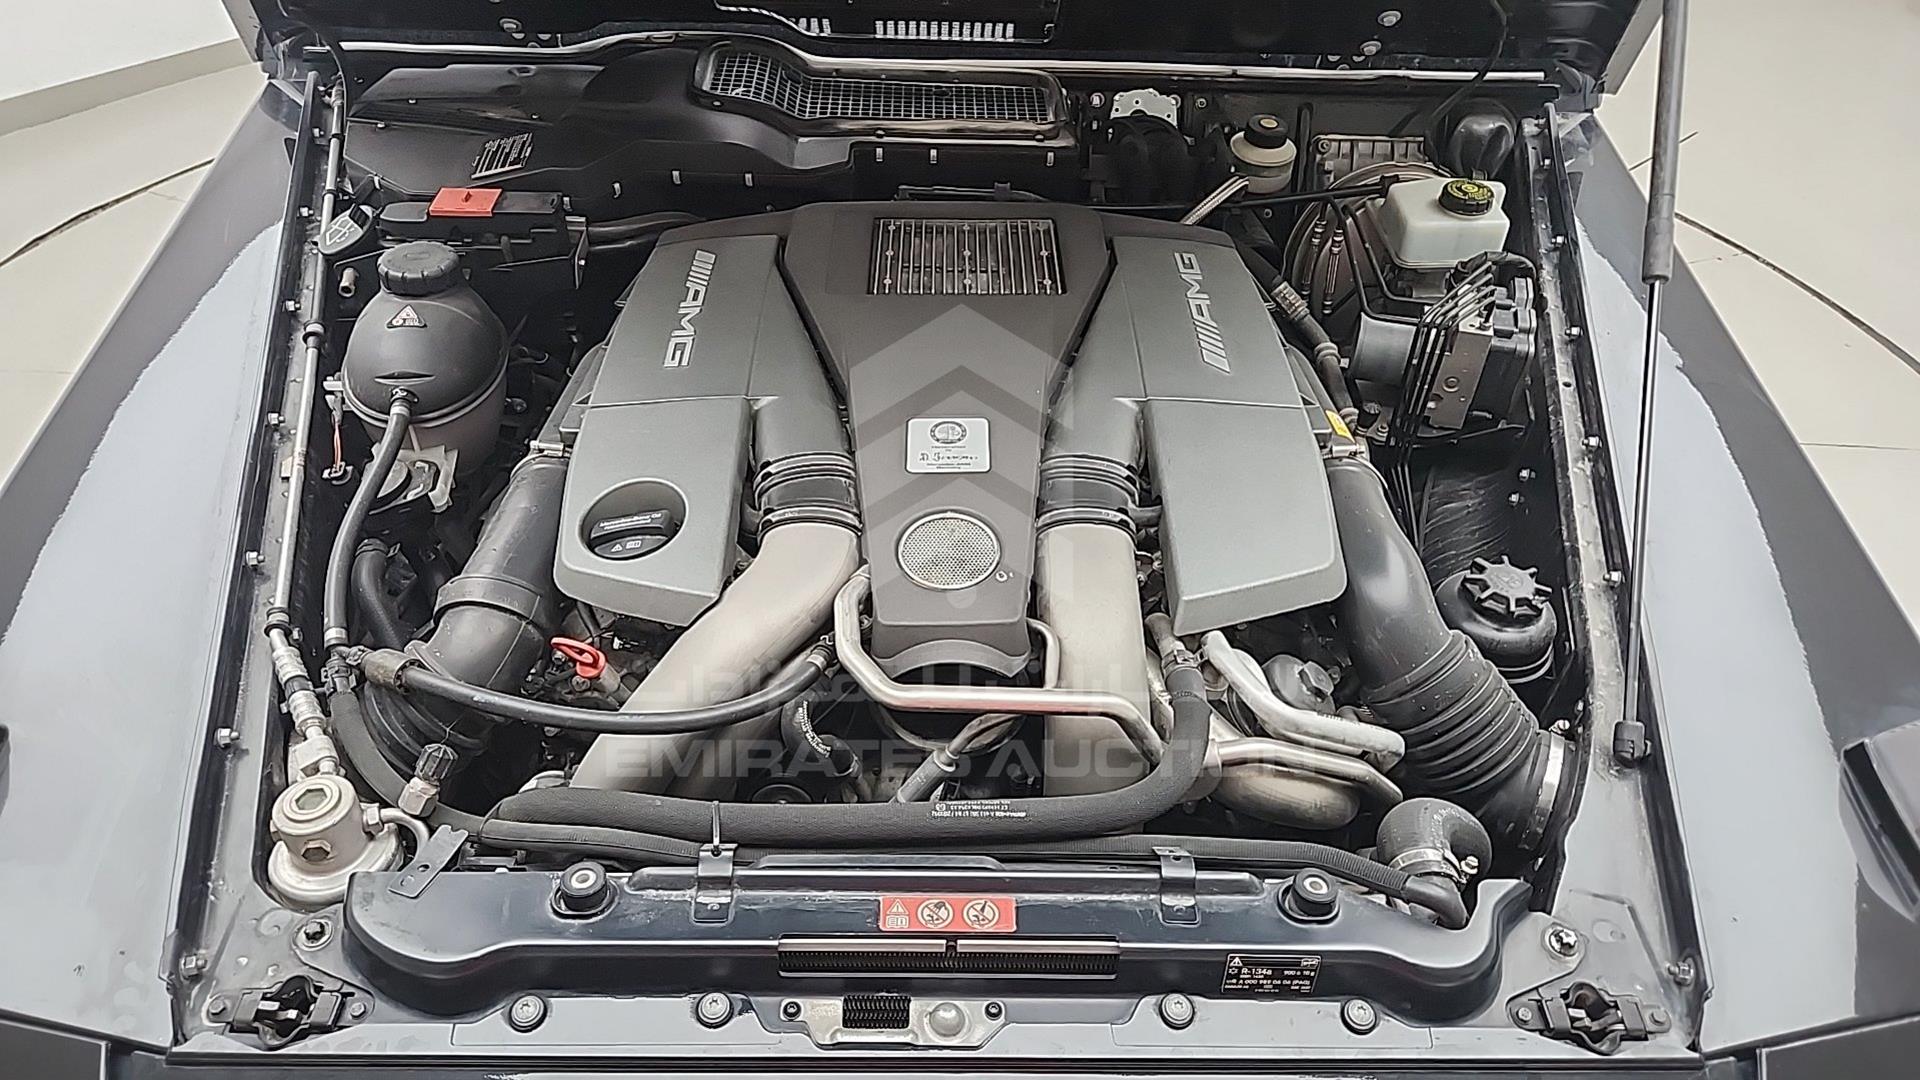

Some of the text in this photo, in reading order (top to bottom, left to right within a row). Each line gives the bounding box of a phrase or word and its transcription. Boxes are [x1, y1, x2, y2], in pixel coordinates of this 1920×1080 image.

[663, 268, 712, 368] AMG
[1173, 252, 1223, 347] AMG
[1241, 967, 1273, 976] R-134a
